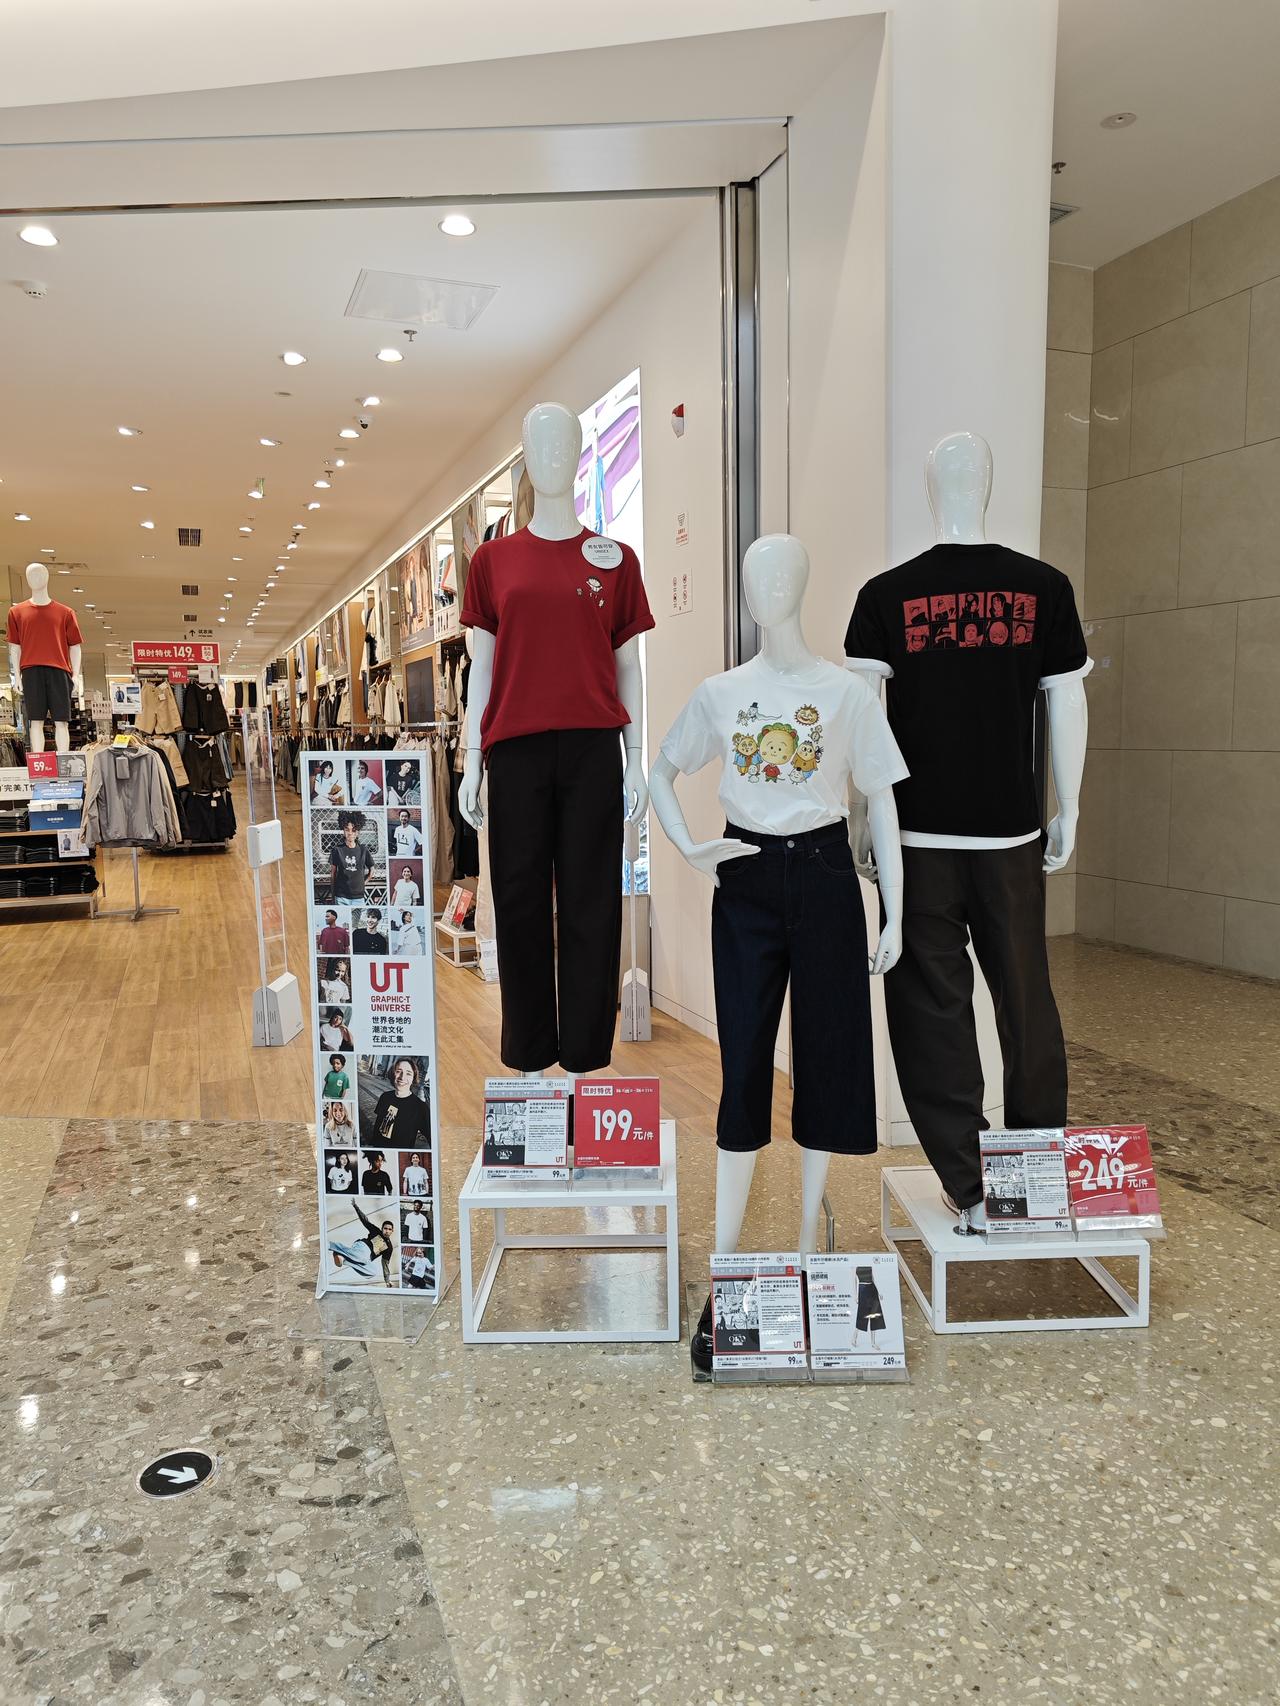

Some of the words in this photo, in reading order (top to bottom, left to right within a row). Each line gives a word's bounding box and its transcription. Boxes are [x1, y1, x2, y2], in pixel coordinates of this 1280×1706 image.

[369, 962, 410, 993] UT
[370, 995, 411, 1003] GRAPHIC-T
[371, 1004, 411, 1012] UNIVERSE
[372, 1016, 411, 1025] 世界各地的
[372, 1026, 404, 1034] 潮流文化
[372, 1035, 404, 1044] 在此汇集
[582, 1087, 612, 1095] 限时特优
